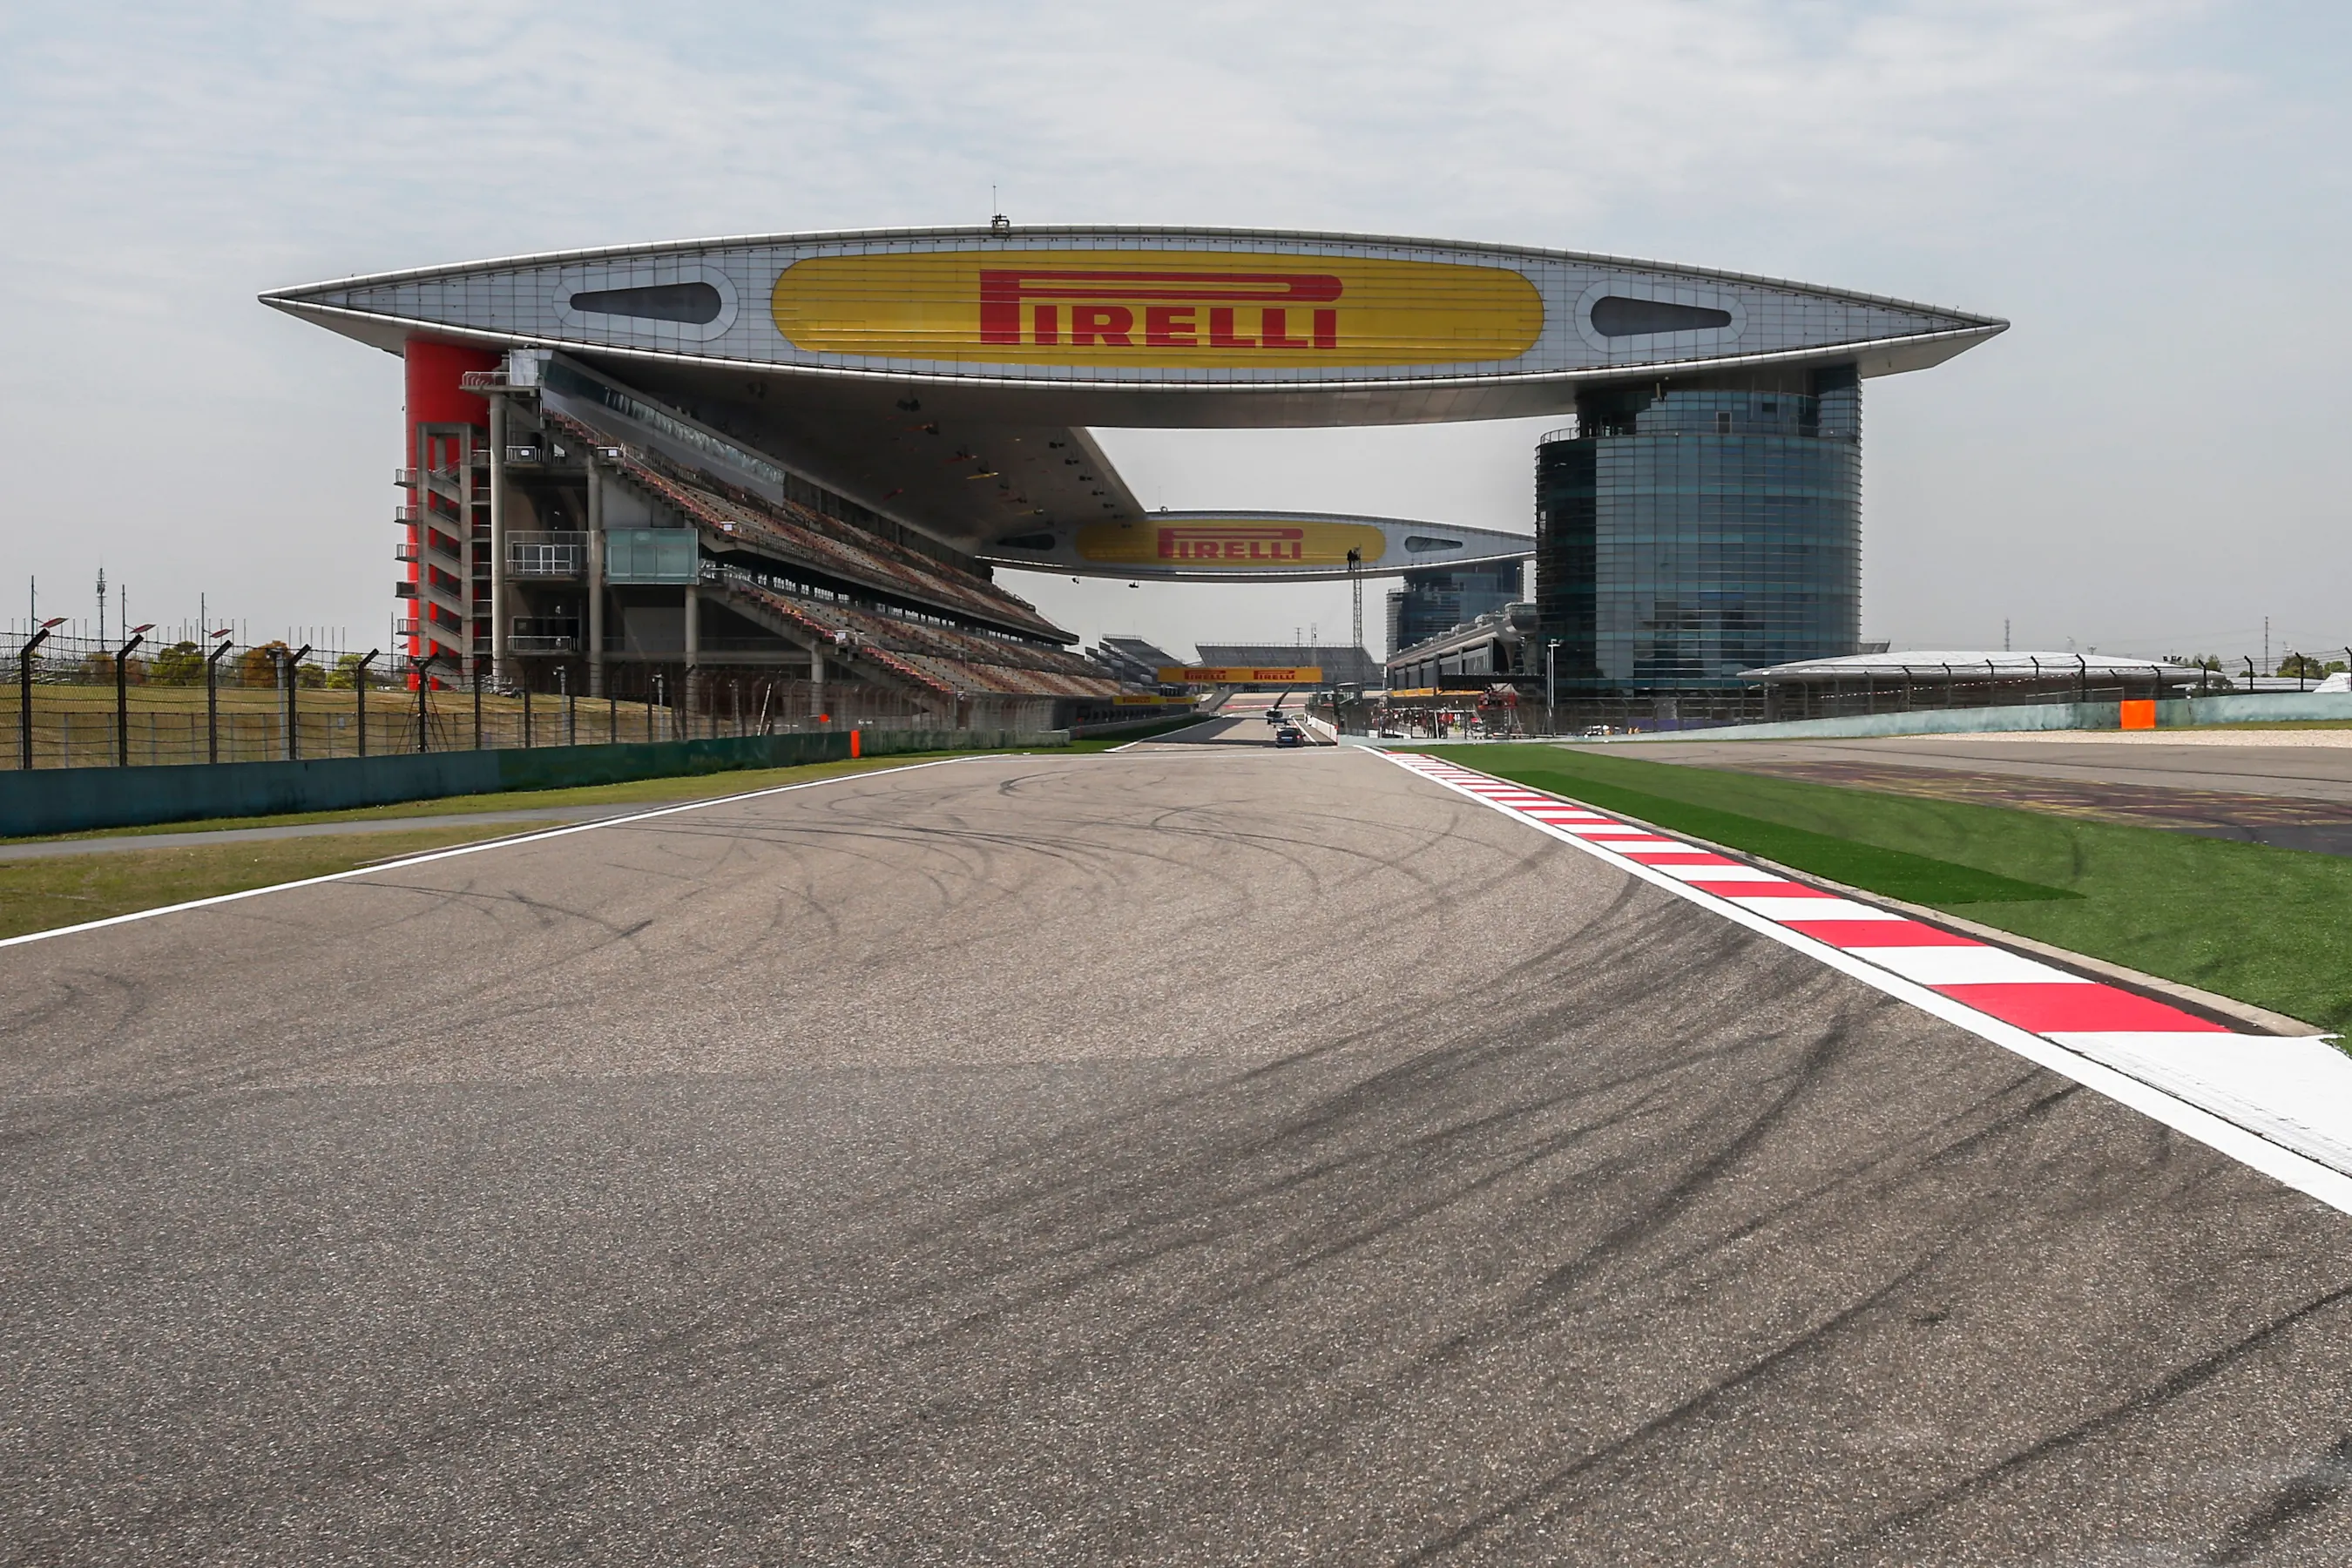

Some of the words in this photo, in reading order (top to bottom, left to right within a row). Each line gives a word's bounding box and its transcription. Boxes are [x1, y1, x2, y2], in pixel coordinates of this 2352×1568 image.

[980, 269, 1343, 349] PIRELLI
[1158, 527, 1304, 559] PIRELLI
[1184, 670, 1227, 680] PIRELLI
[1253, 670, 1295, 680] PIRELLI
